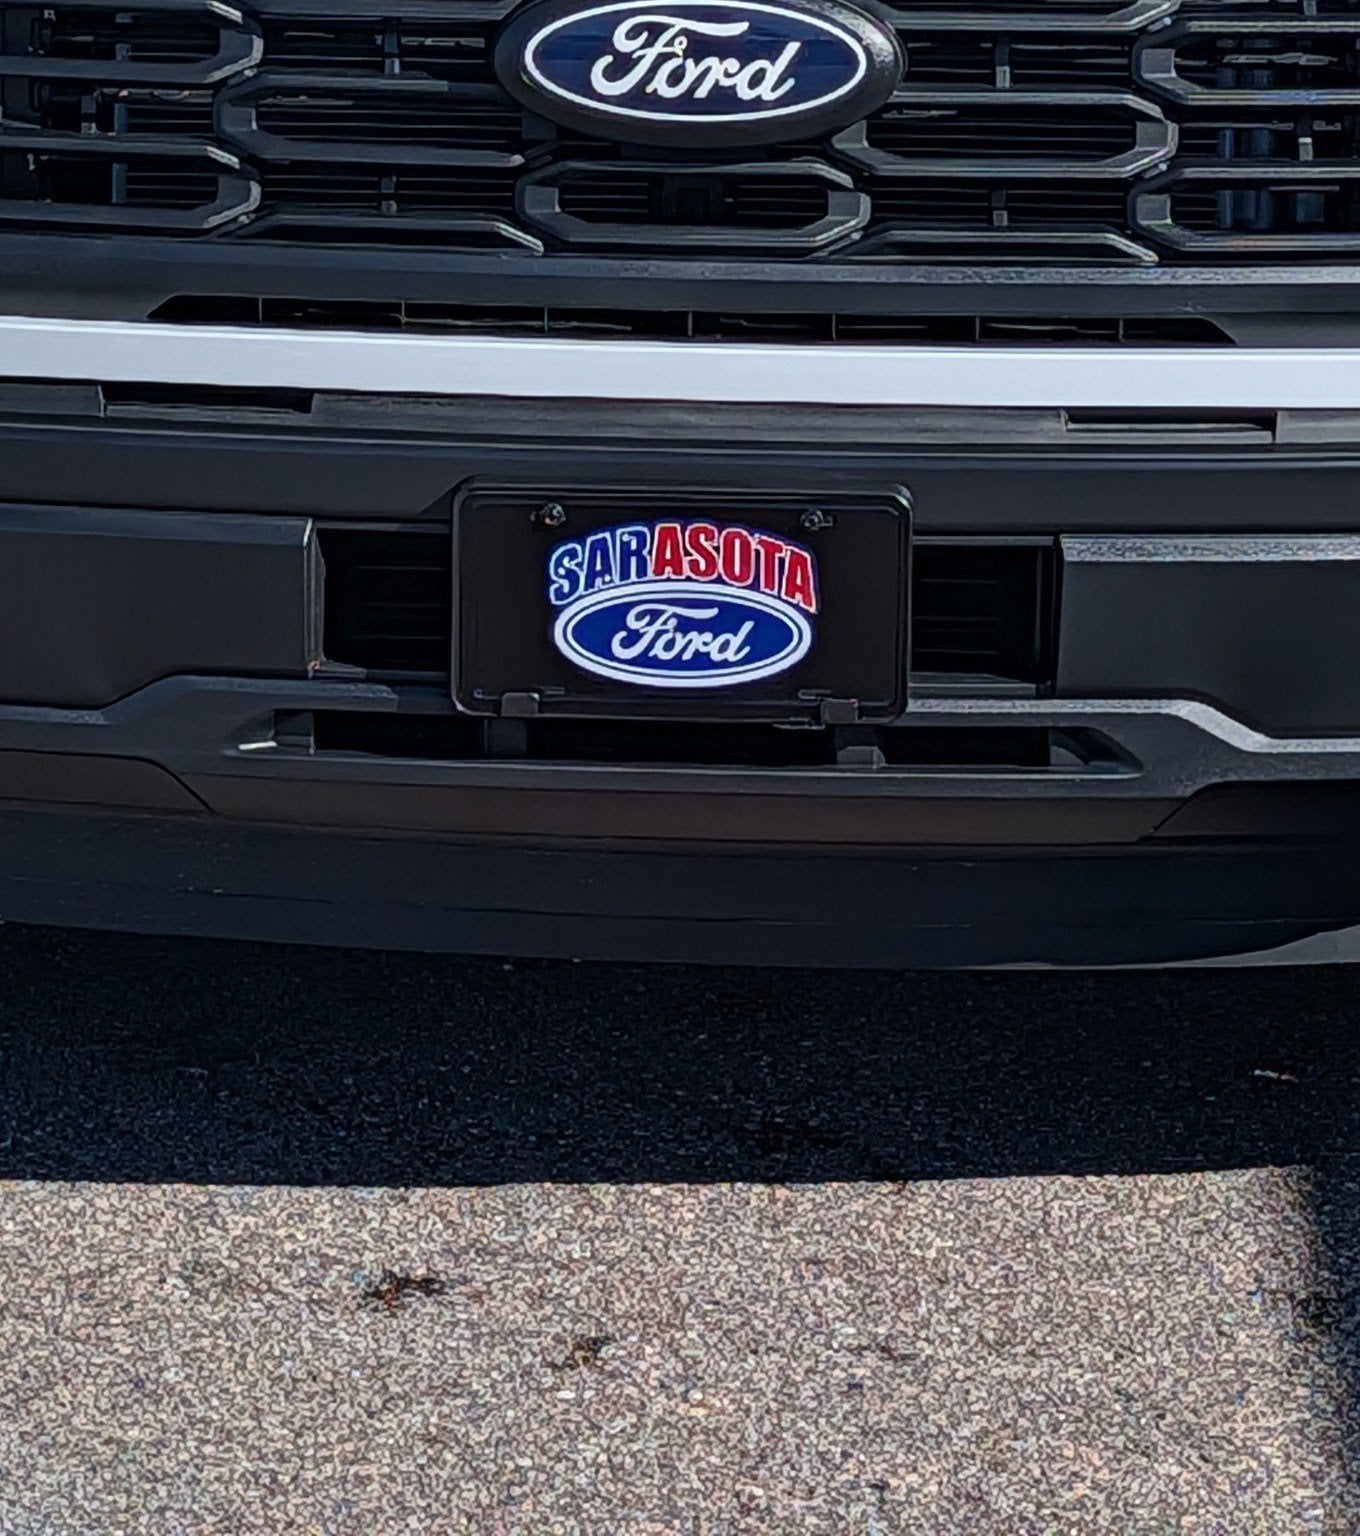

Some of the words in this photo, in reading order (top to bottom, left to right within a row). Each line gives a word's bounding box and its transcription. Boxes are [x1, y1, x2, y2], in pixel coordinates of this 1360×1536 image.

[590, 14, 802, 102] Ford
[549, 523, 818, 614] SARASOTA
[610, 602, 755, 663] Ford
